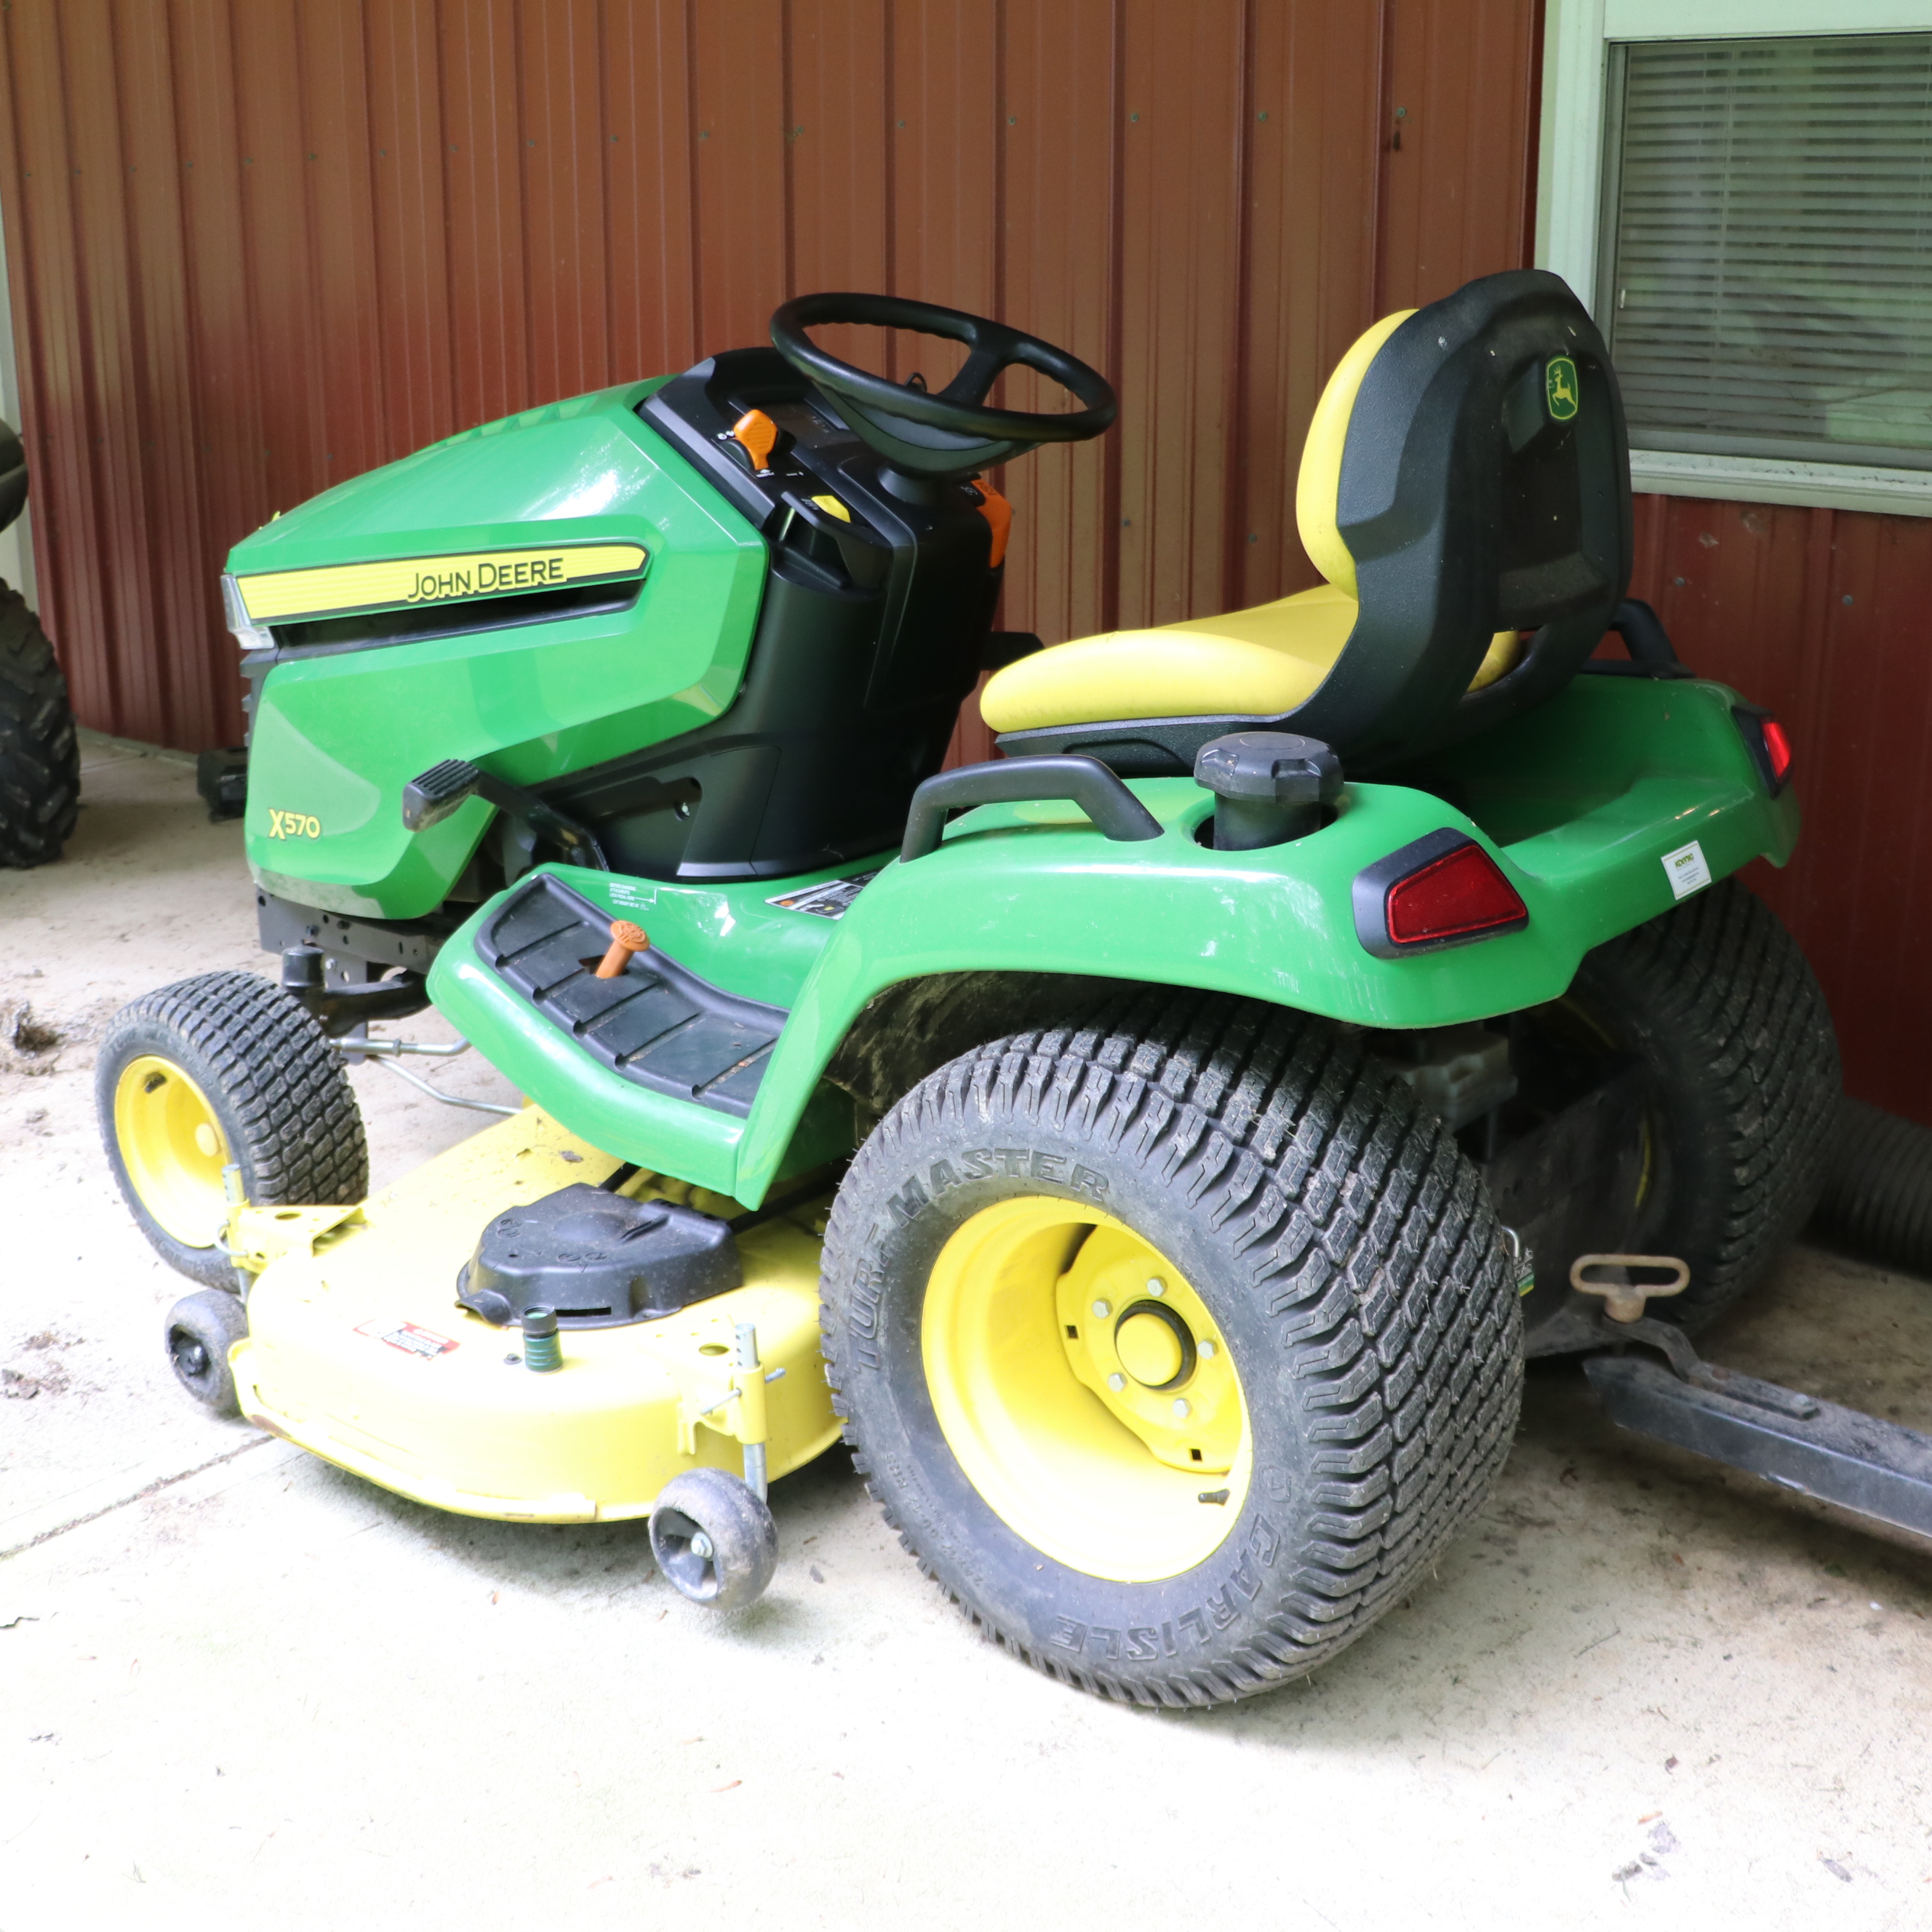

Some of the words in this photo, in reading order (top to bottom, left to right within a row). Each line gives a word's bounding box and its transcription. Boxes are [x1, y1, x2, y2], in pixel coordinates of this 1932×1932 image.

[407, 570, 471, 599] JOHN
[478, 557, 564, 590] DEERE
[268, 807, 322, 841] X570
[849, 1223, 890, 1373] TURF
[885, 1146, 1110, 1229] MASTER
[1050, 1514, 1281, 1661] CARLISLE
